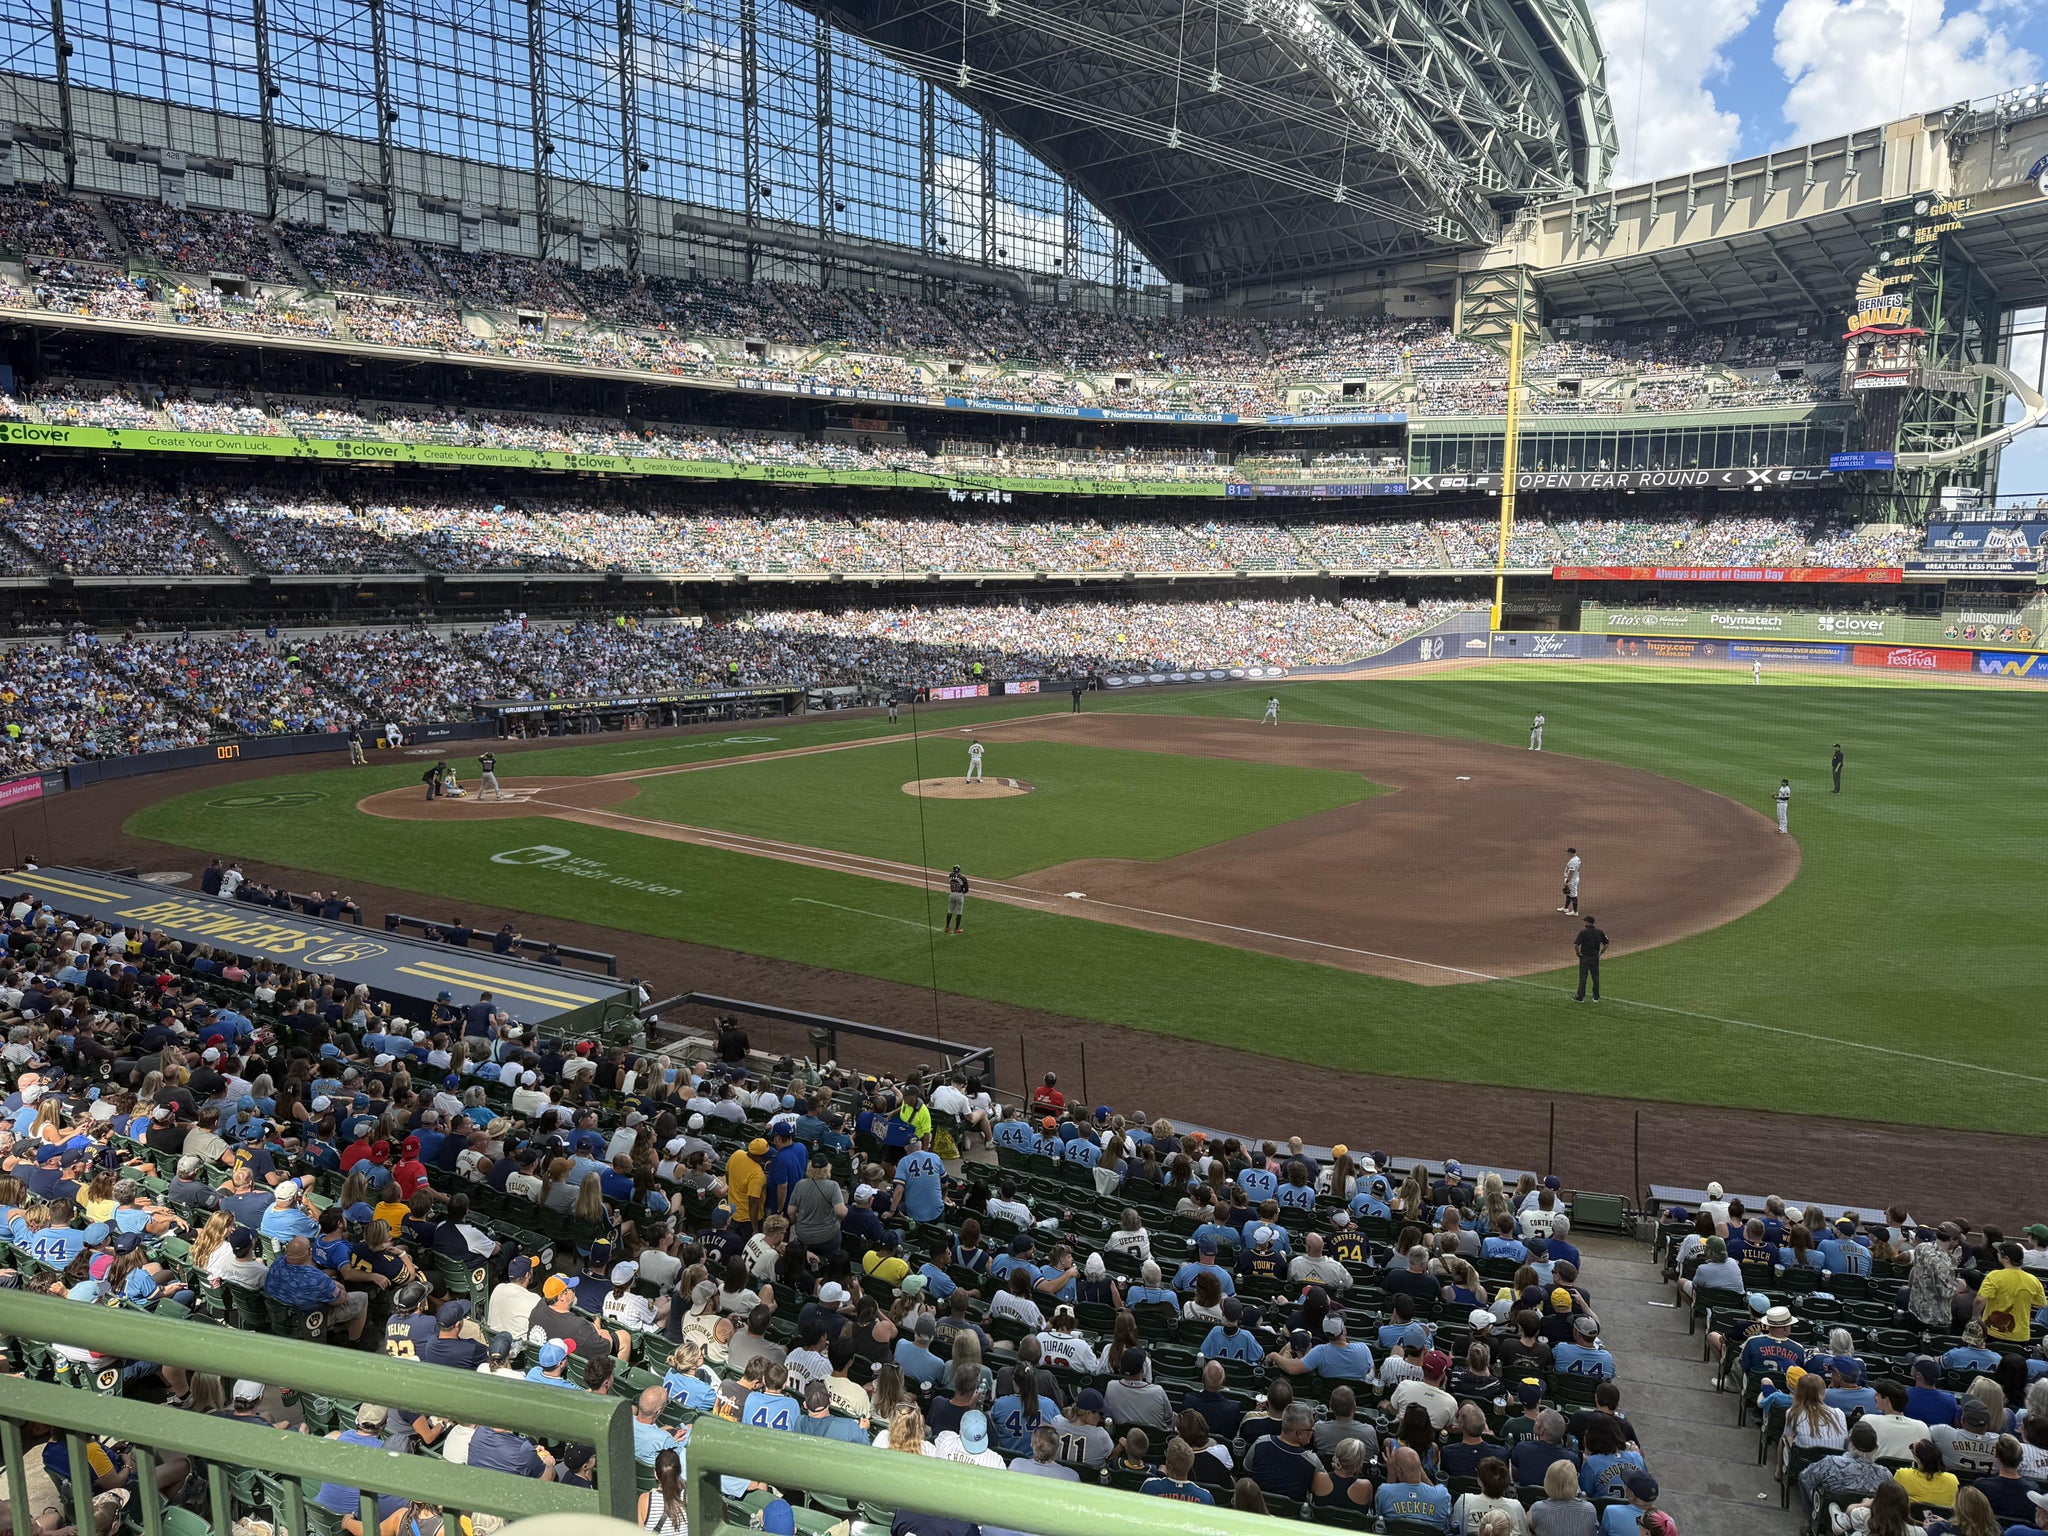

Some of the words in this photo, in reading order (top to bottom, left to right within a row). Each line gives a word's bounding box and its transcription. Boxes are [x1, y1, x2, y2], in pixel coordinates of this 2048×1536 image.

[166, 151, 180, 160] 428
[1930, 198, 1971, 217] GONE!
[1915, 226, 1932, 236] GET
[1933, 221, 1962, 233] OUTTA
[1914, 233, 1938, 244] HERE
[1894, 256, 1911, 267] GET
[1912, 254, 1925, 264] UP
[1884, 275, 1899, 285] GET
[1901, 273, 1914, 283] UP
[1858, 294, 1903, 311] BERNIE'S
[1848, 305, 1911, 331] CHALET
[973, 401, 1013, 410] Northwestern
[1014, 403, 1035, 412] Mutual
[1041, 406, 1064, 415] LEGENDS
[1065, 408, 1079, 416] CLUB
[1110, 411, 1153, 420] Northwestern
[1154, 412, 1175, 421] Mutual
[1182, 413, 1207, 422] LEGENDS
[1208, 414, 1222, 422] CLUB
[11, 425, 70, 441] clover
[148, 435, 185, 446] Create
[188, 437, 213, 447] Your
[216, 438, 242, 449] Own
[244, 440, 271, 450] Luck.
[353, 443, 398, 457] clover
[424, 449, 453, 459] Create
[455, 451, 475, 460] Your
[477, 452, 498, 462] Own
[500, 453, 521, 463] Luck.
[578, 456, 615, 468] clover
[643, 462, 667, 472] Create
[669, 463, 685, 472] Your
[686, 465, 703, 473] Own
[704, 466, 722, 475] Luck.
[776, 468, 808, 479] clover
[850, 474, 871, 482] Create
[872, 475, 886, 483] Your
[887, 476, 902, 484] Own
[903, 476, 918, 484] Luck.
[965, 476, 992, 487] clover
[1006, 481, 1024, 489] Create
[1026, 481, 1037, 490] Your
[1038, 482, 1051, 490] Own
[1052, 482, 1065, 490] Luck.
[1100, 482, 1126, 492] clover
[1146, 485, 1167, 493] Create
[1167, 485, 1180, 493] Your
[1410, 476, 1434, 490] X
[1439, 477, 1490, 488] GOLF
[1519, 474, 1572, 488] OPEN
[1580, 473, 1629, 487] YEAR
[1639, 471, 1709, 486] ROUND
[1746, 469, 1773, 484] X
[1777, 469, 1834, 481] GOLF
[1228, 485, 1241, 495] 81
[1384, 485, 1404, 494] 2:38
[1934, 539, 1956, 547] BREW
[1957, 539, 1978, 547] CREW
[1656, 568, 1689, 580] Always
[1691, 570, 1697, 578] a
[1699, 569, 1720, 580] part
[1722, 568, 1732, 578] of
[1733, 568, 1762, 579] Game
[1765, 569, 1784, 580] Day
[1968, 563, 1985, 571] LESS
[1986, 563, 2014, 571] FILLING.
[1505, 602, 1535, 612] Barrel
[1537, 602, 1562, 613] Yard
[1608, 614, 1640, 625] Tito's
[1710, 614, 1782, 627] Polymatech
[1835, 616, 1885, 630] clover
[1957, 608, 2022, 625] Johnsonville
[1647, 642, 1695, 653] hupy.com
[1887, 651, 1937, 668] festival
[217, 745, 240, 759] 007
[12, 781, 41, 797] Network
[114, 901, 333, 953] BREWERS
[1001, 1128, 1024, 1145] 44
[1033, 1139, 1055, 1156] 44
[1068, 1144, 1090, 1163] 44
[908, 1157, 934, 1177] 44
[1245, 1173, 1270, 1191] 44
[1283, 1190, 1308, 1209] 44
[1530, 1218, 1552, 1228] CONTRE
[701, 1235, 727, 1249] ELICH
[1119, 1235, 1145, 1247] UECKER
[1331, 1231, 1364, 1245] CONTRERAS
[34, 1237, 67, 1261] 44
[1337, 1245, 1363, 1262] 24
[1743, 1250, 1771, 1261] YELICH
[1252, 1260, 1276, 1270] YOUNT
[1846, 1255, 1859, 1273] 11
[604, 1300, 626, 1313] BRAUN
[1042, 1340, 1076, 1358] TURANG
[1566, 1359, 1604, 1378] 44
[752, 1406, 789, 1431] 44
[1005, 1410, 1041, 1438] 44
[1060, 1432, 1086, 1463] 11
[1952, 1440, 1996, 1456] GONZALE
[1393, 1500, 1435, 1517] UECKER
